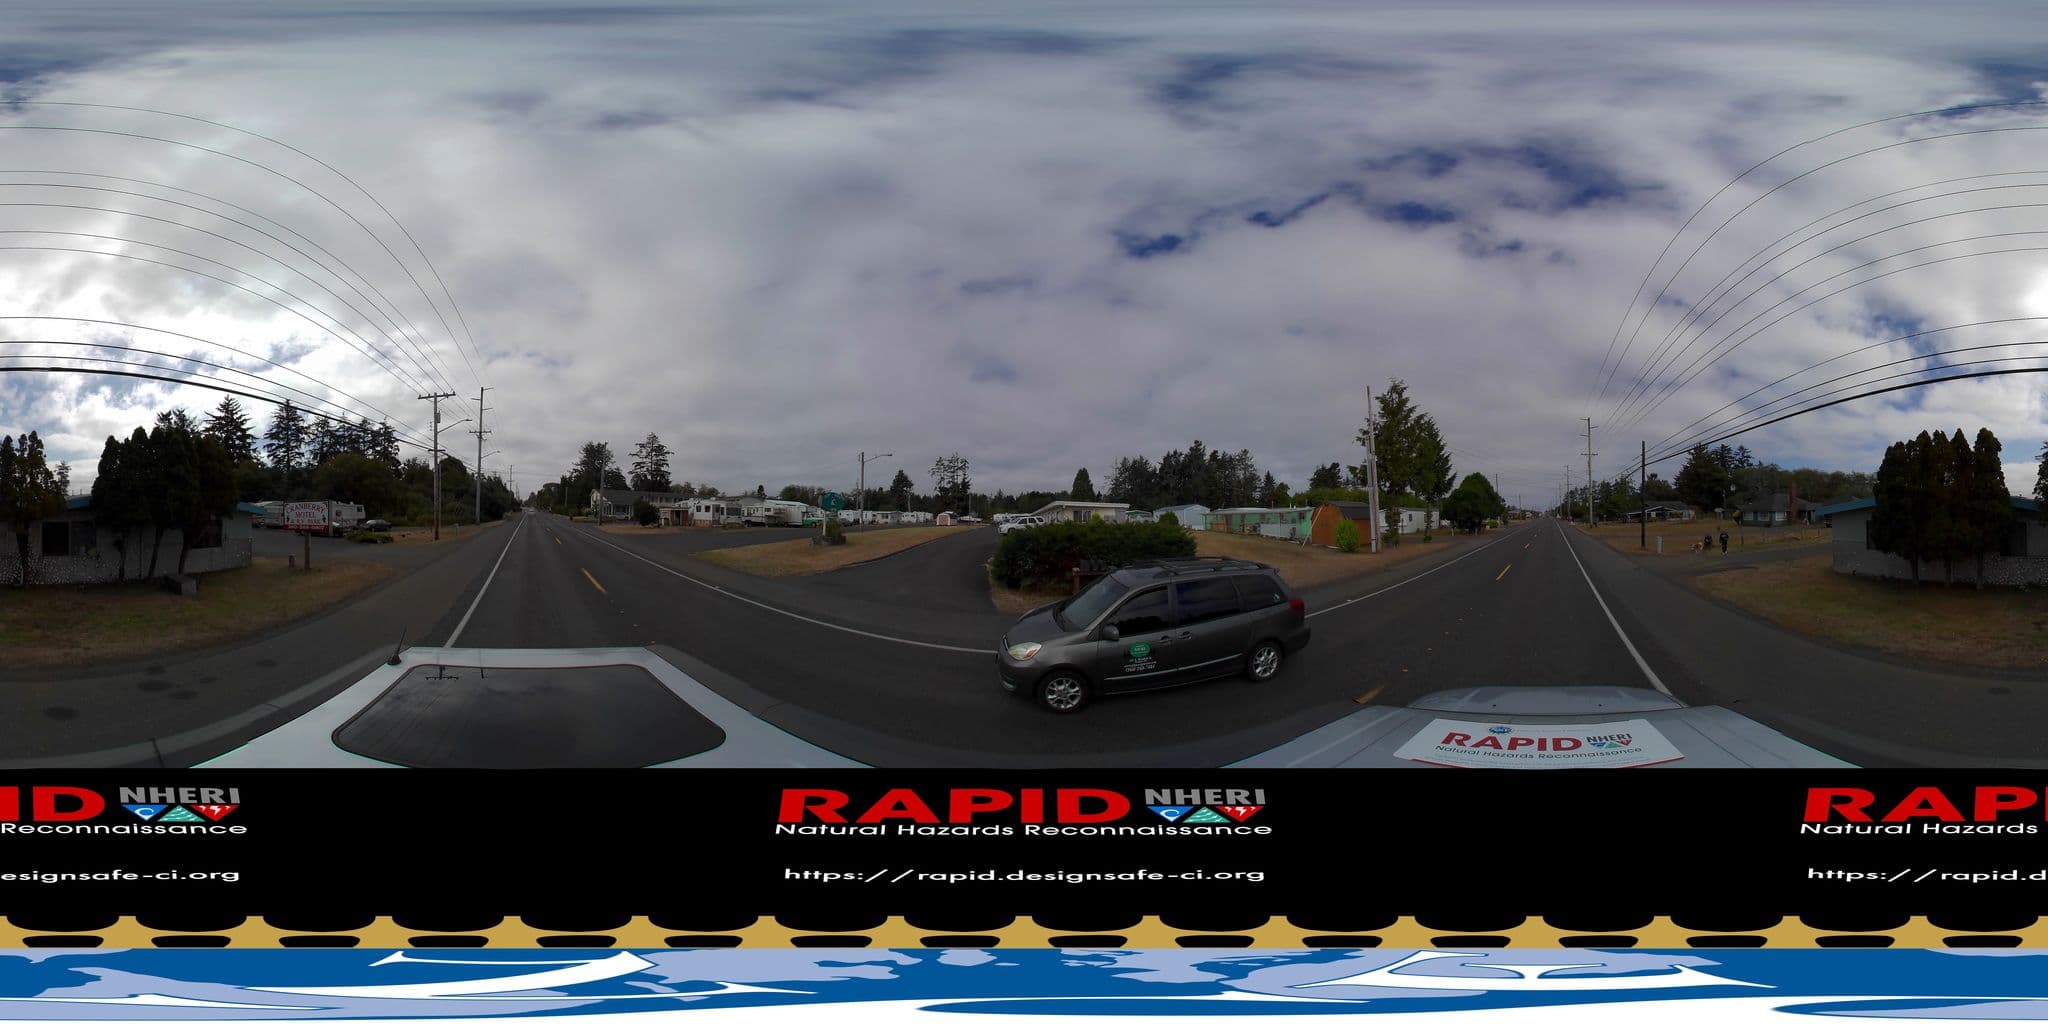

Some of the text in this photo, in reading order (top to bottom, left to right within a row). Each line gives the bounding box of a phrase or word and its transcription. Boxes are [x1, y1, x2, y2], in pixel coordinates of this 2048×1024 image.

[288, 503, 324, 513] CRANBERRY
[1441, 732, 1633, 751] RAPID NHERI
[1435, 745, 1642, 759] Natural Hazards Reconnaissance
